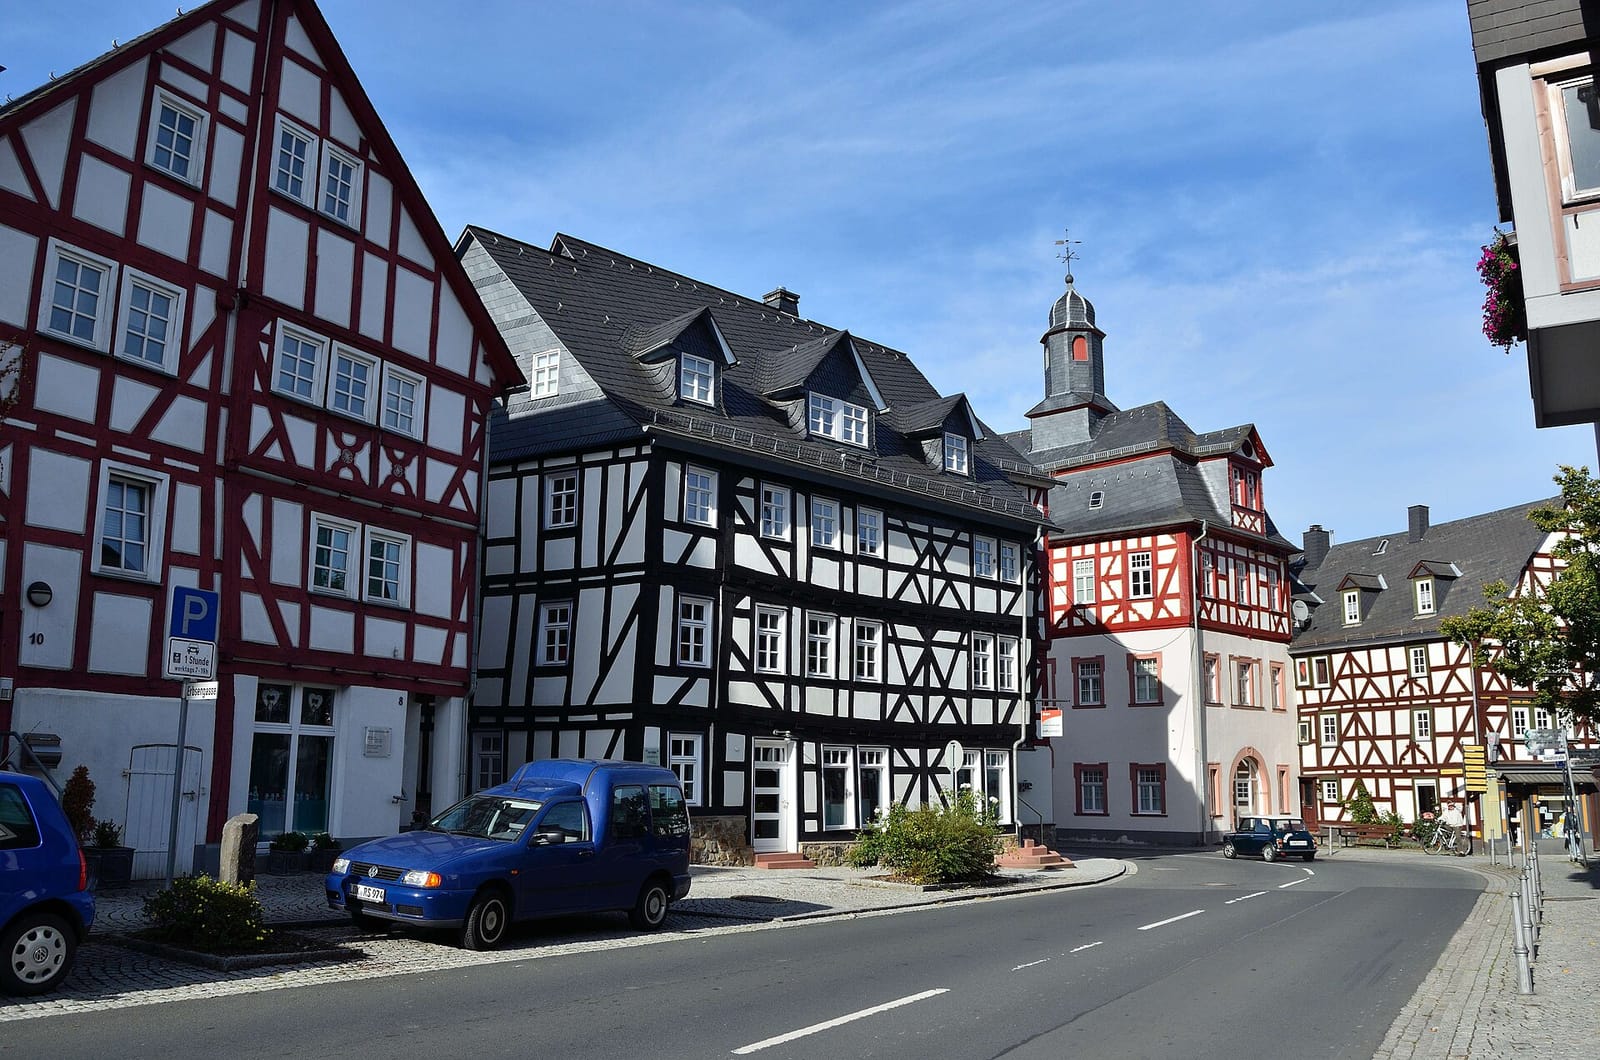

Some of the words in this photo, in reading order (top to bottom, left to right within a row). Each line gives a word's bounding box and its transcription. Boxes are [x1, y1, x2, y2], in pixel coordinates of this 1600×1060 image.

[182, 594, 208, 634] P
[28, 632, 44, 645] 10
[184, 655, 188, 664] 1
[188, 656, 209, 666] Stunde
[187, 685, 216, 698] Erbsengasse
[398, 696, 404, 706] 8
